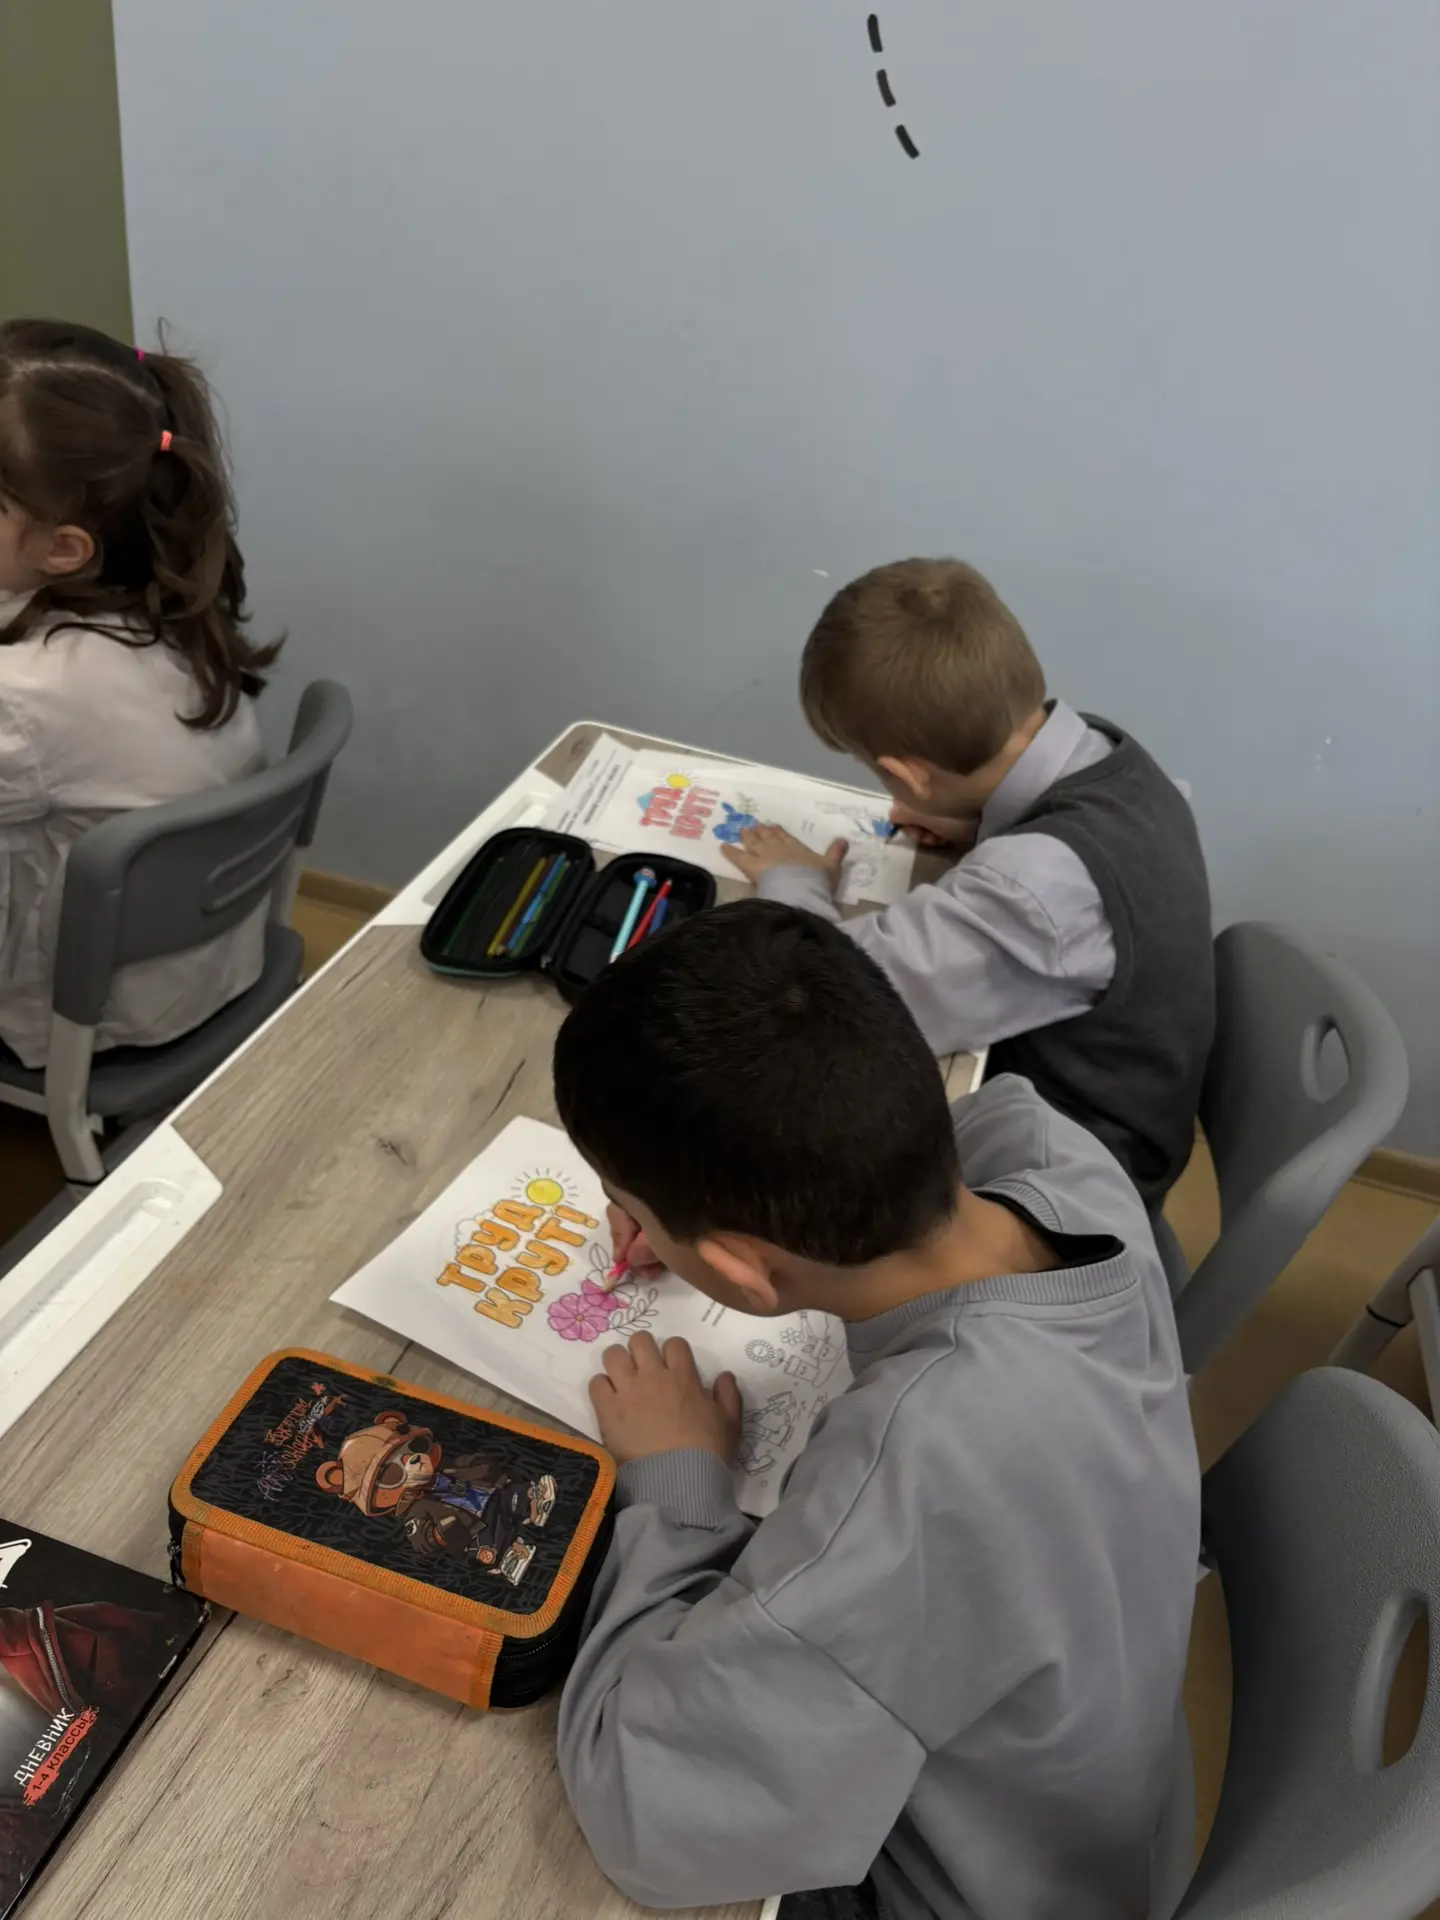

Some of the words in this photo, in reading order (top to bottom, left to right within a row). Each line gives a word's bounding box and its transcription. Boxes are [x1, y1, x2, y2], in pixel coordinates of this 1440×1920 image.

[436, 1199, 545, 1293] ТРУД
[474, 1204, 599, 1329] КРУТ!
[14, 1707, 75, 1787] ДНЕВНИК
[33, 1773, 49, 1790] 1-4
